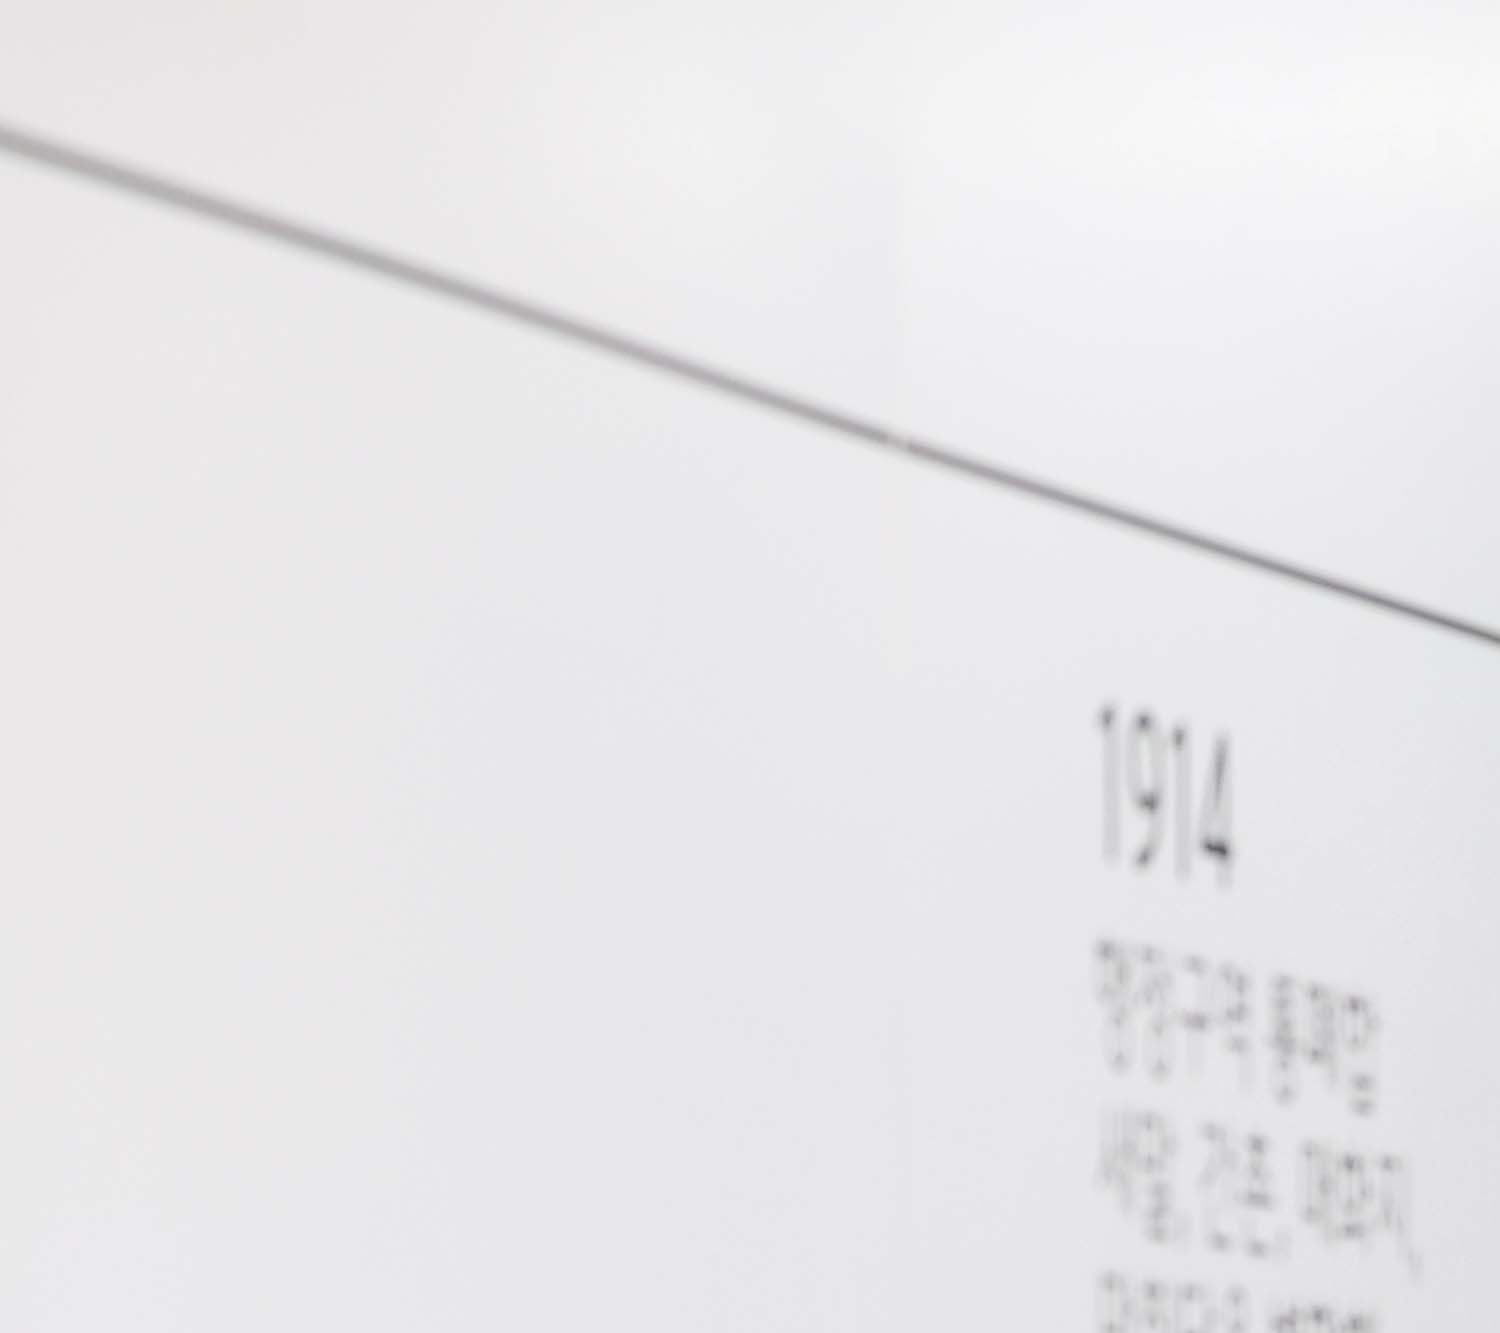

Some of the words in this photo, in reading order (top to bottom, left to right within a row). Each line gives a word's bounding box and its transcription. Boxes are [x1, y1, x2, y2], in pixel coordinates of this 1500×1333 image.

[1096, 701, 1236, 887] 1914
[1089, 933, 1253, 1082] 행정구역
[1267, 972, 1382, 1119] 통폐합
